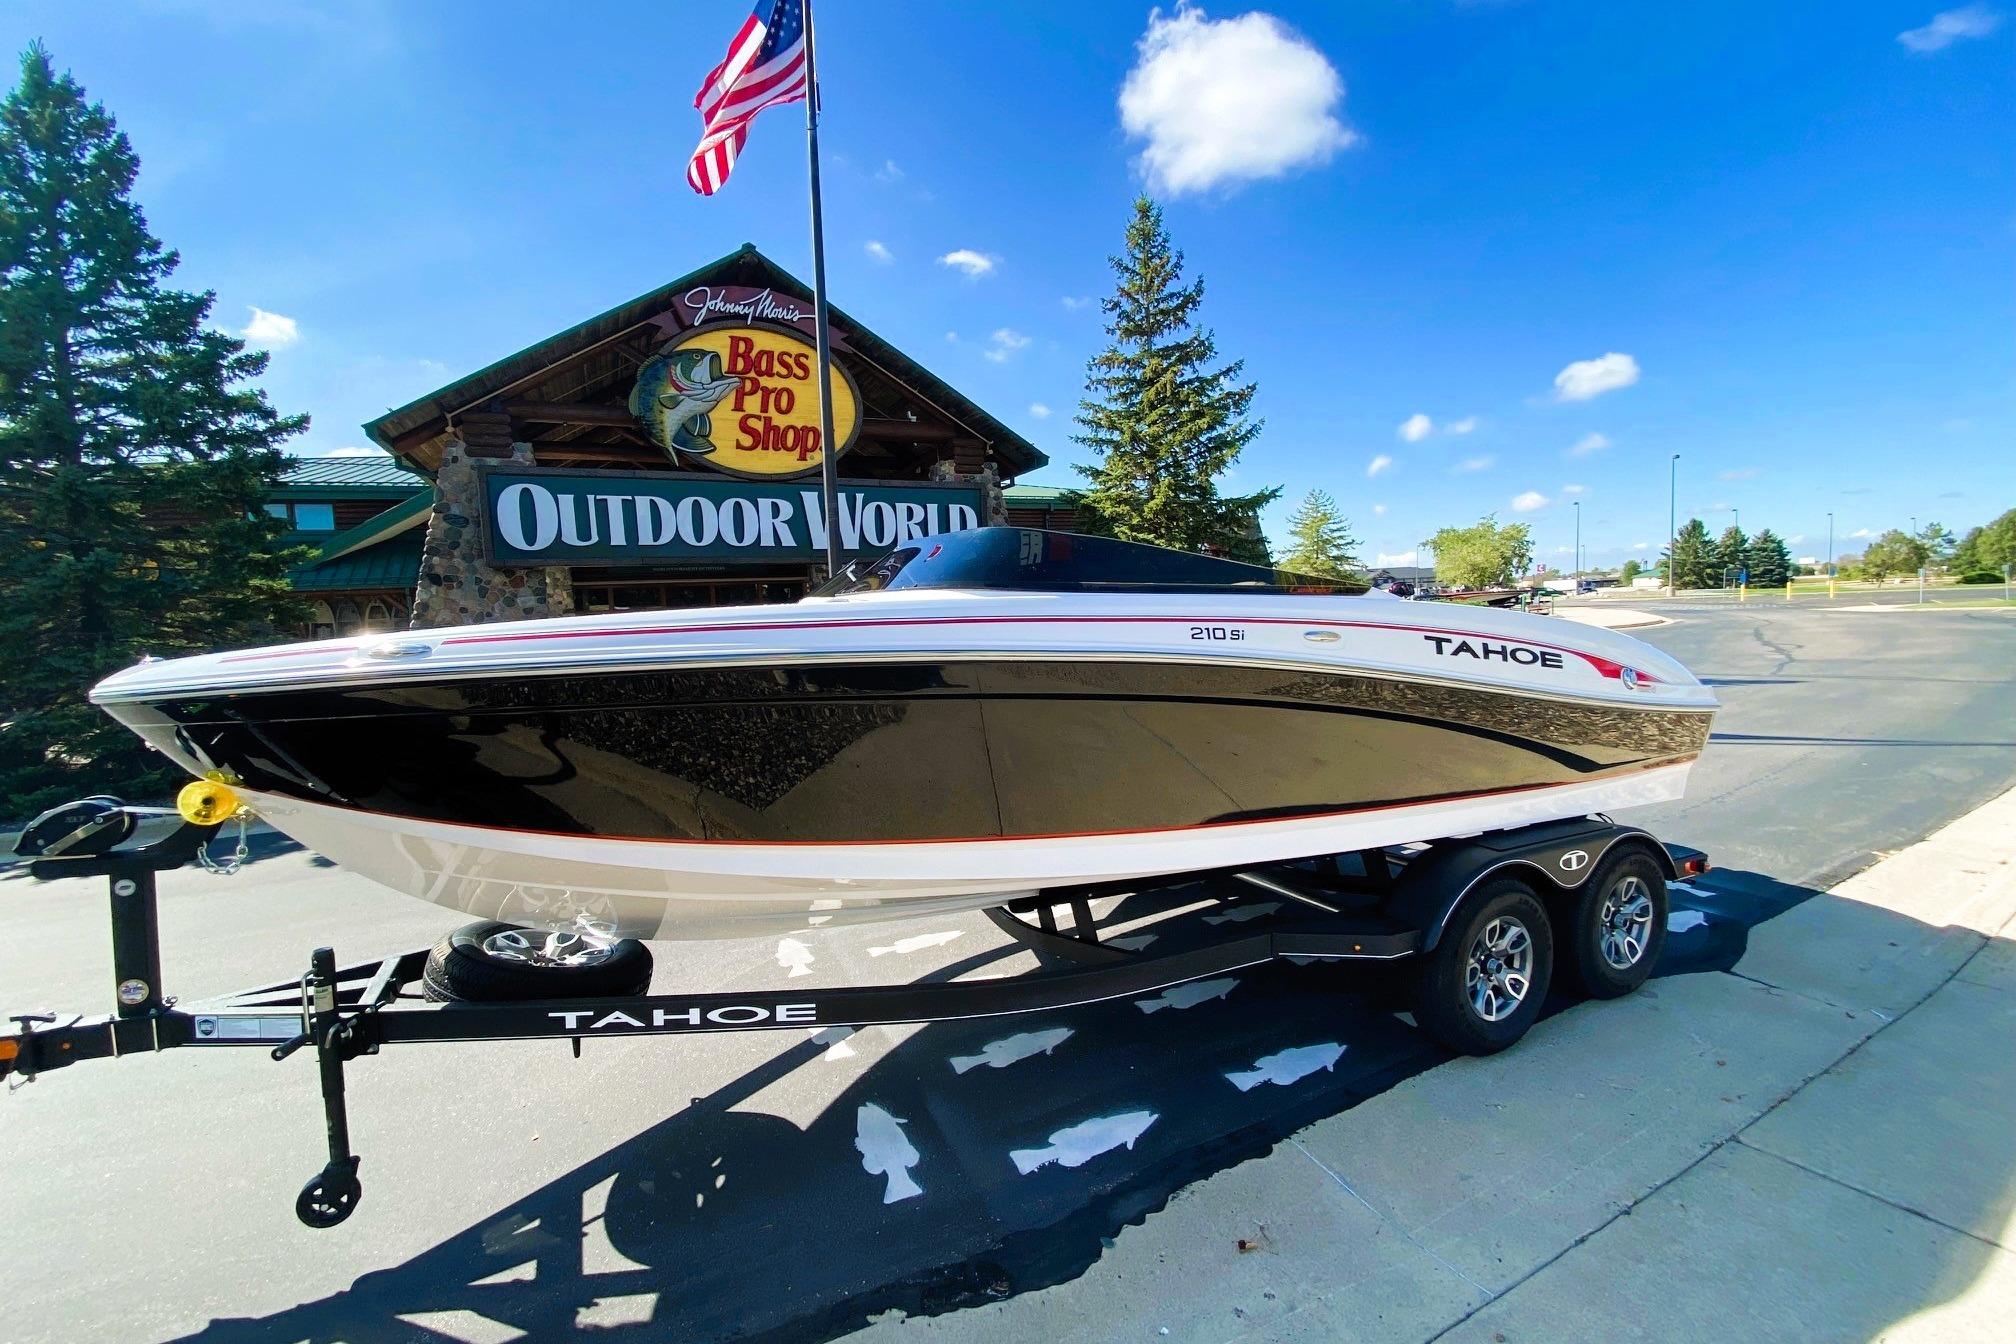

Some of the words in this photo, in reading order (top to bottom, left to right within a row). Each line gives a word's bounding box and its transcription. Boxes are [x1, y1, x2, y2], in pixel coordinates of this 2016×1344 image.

[685, 286, 755, 326] Johnny
[740, 288, 817, 322] Morris
[724, 335, 810, 381] Bass
[731, 376, 795, 415] Pro
[735, 413, 824, 462] Shop
[497, 483, 798, 551] OUTDOOR
[1190, 626, 1227, 640] 210
[1424, 635, 1564, 669] TAHOE
[548, 1003, 817, 1029] TAHOE
